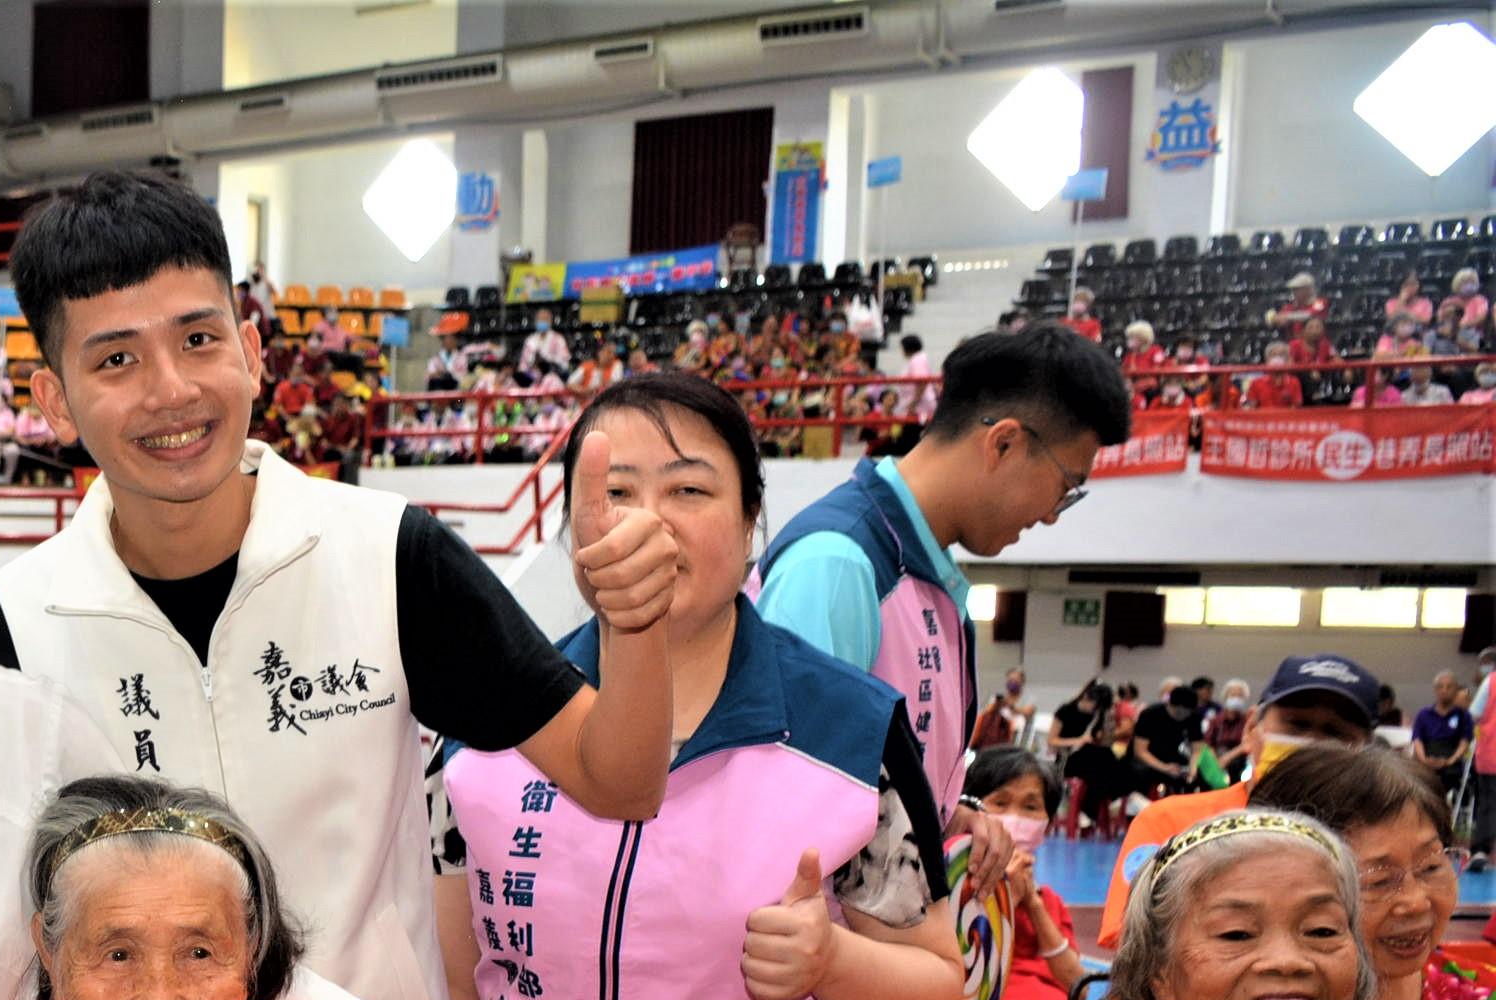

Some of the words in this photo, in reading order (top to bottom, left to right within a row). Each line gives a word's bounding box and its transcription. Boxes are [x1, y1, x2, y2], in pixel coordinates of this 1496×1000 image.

[116, 673, 160, 773] 議員
[253, 641, 307, 736] 嘉義
[299, 706, 334, 722] Chiayi
[335, 702, 358, 717] City
[359, 692, 397, 711] Council
[504, 779, 558, 999] 衛生福利部
